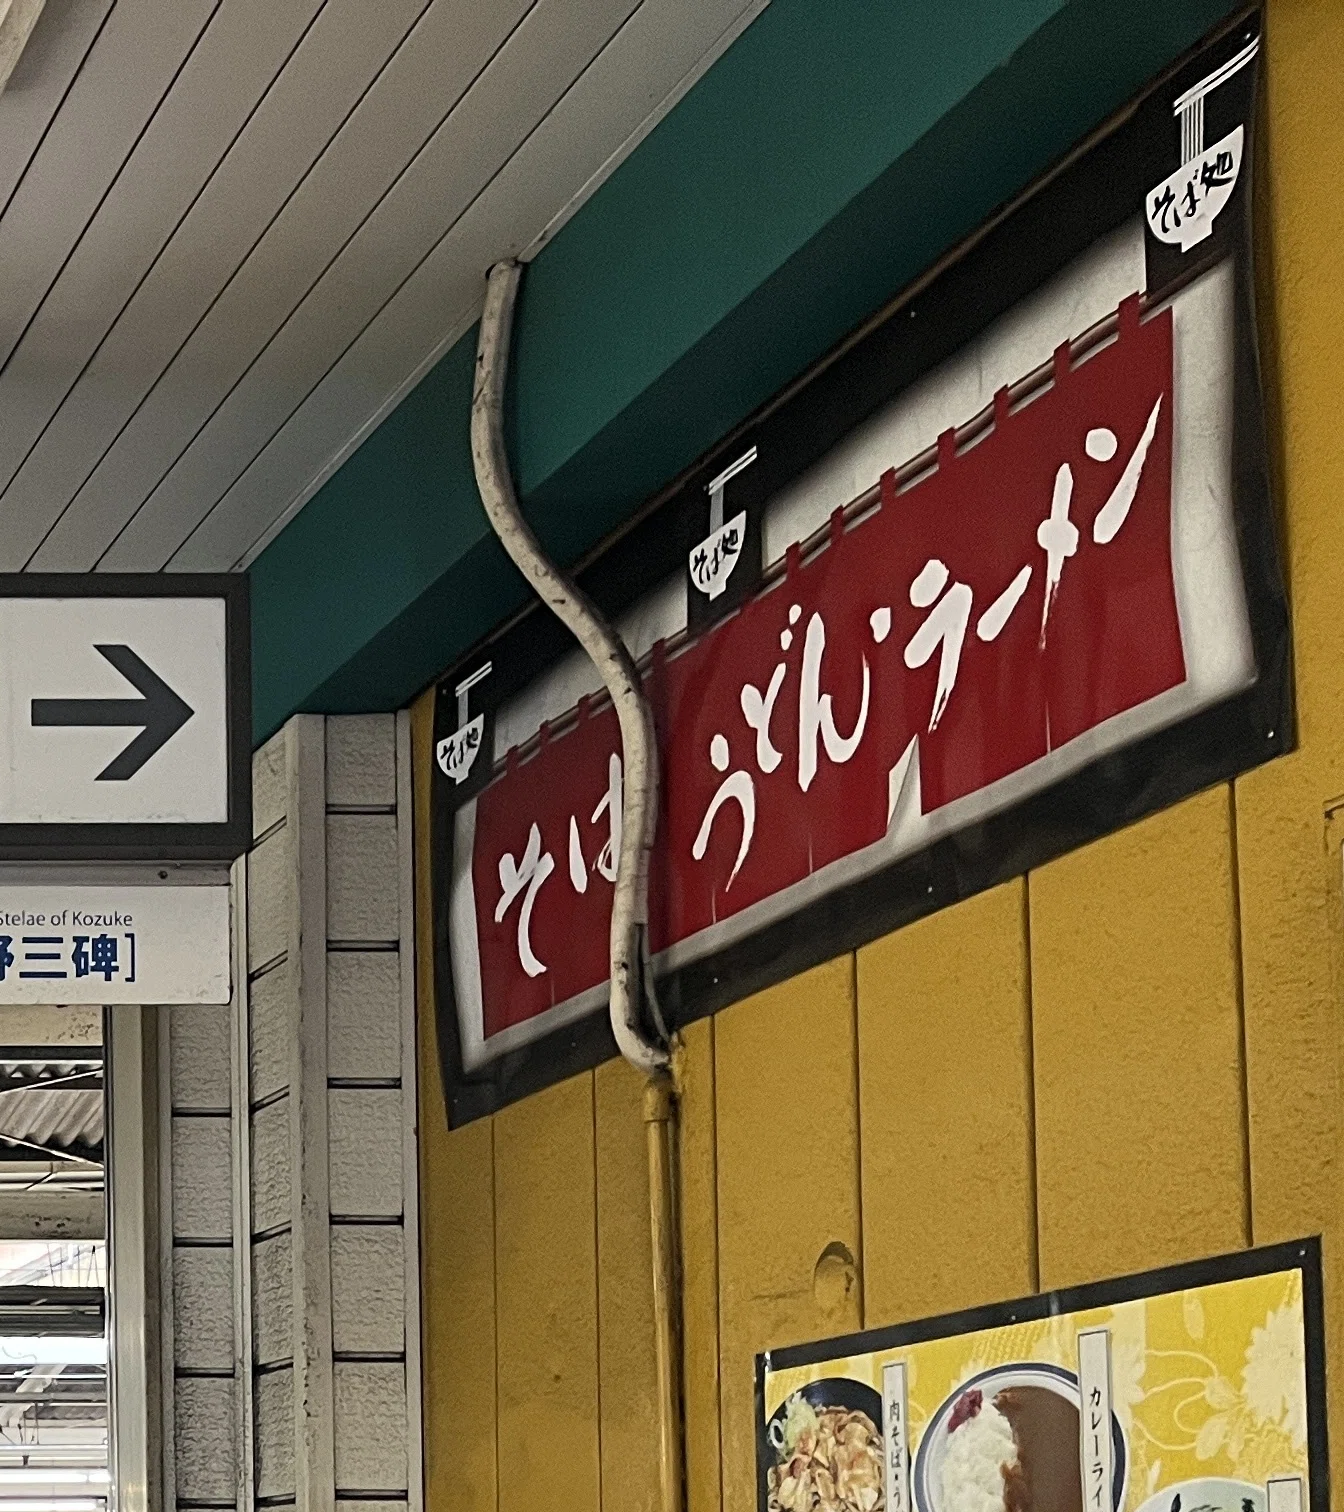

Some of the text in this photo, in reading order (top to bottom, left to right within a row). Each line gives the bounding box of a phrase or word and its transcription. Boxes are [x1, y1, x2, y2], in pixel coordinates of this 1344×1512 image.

[1149, 152, 1234, 234] そば処
[691, 528, 741, 587] そば処
[437, 729, 481, 772] そば処
[49, 911, 68, 927] of
[72, 911, 134, 928] Kozuke
